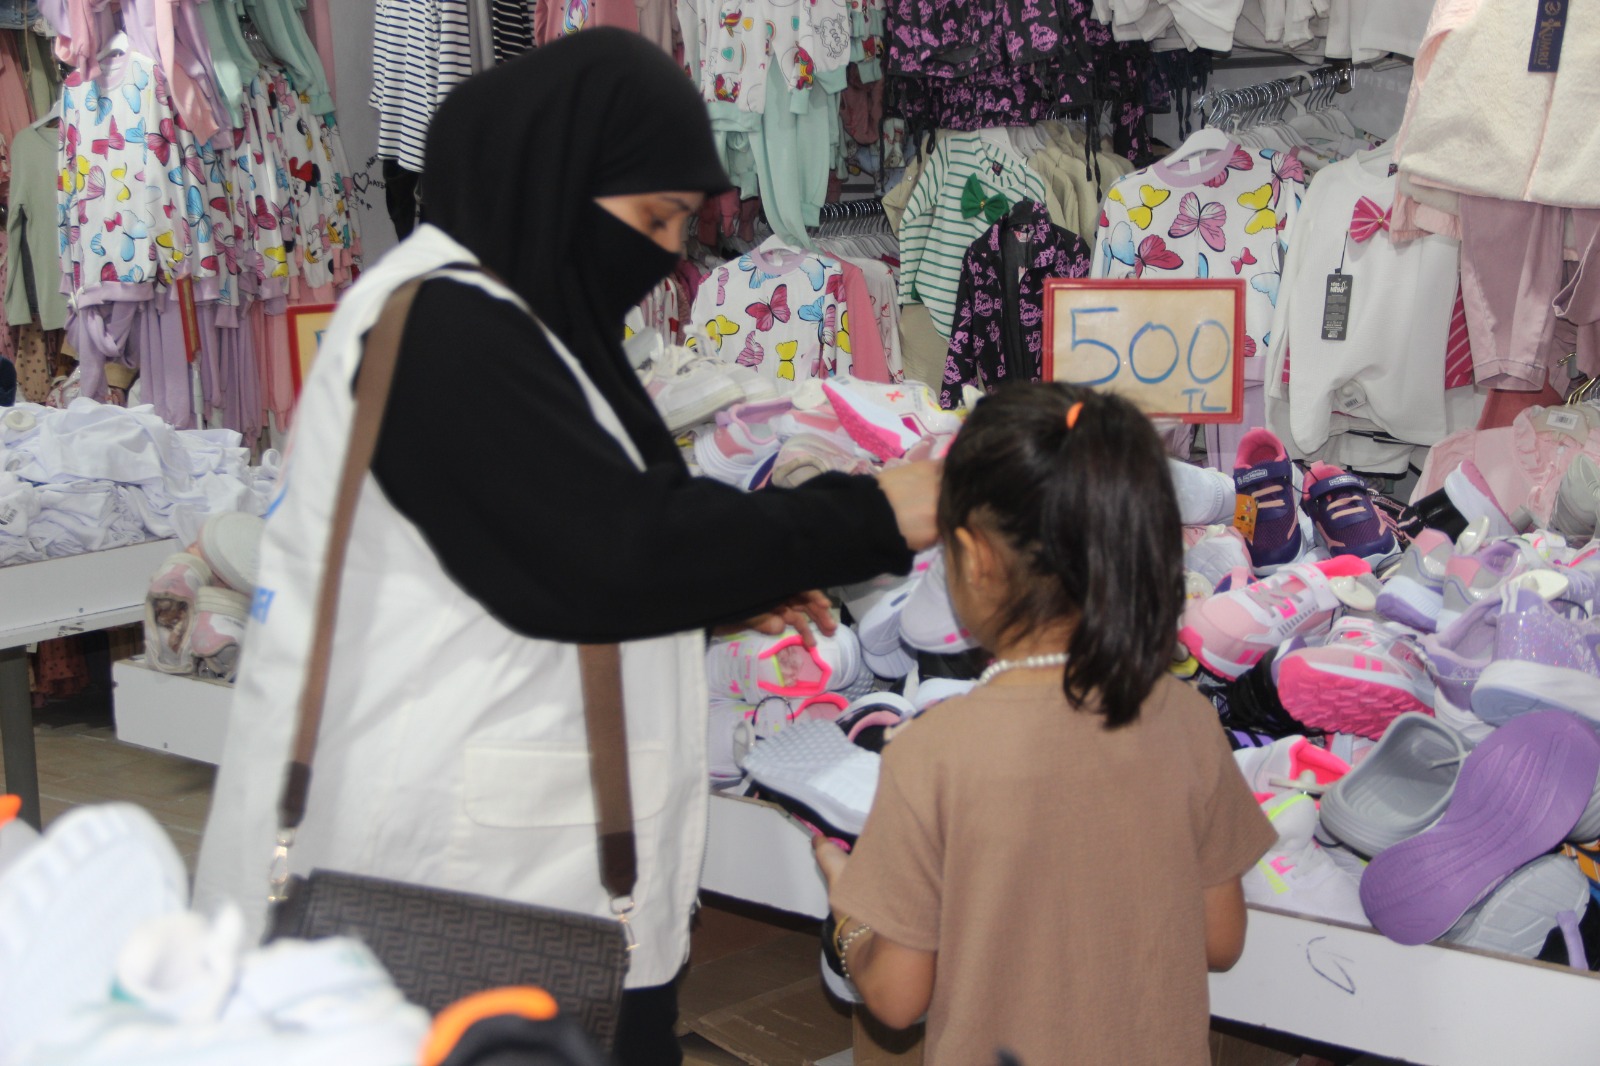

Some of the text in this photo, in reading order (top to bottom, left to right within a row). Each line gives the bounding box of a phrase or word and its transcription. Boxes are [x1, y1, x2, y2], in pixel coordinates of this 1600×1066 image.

[1537, 19, 1561, 65] KUMRU
[1070, 306, 1231, 387] 500
[1181, 388, 1227, 412] TL
